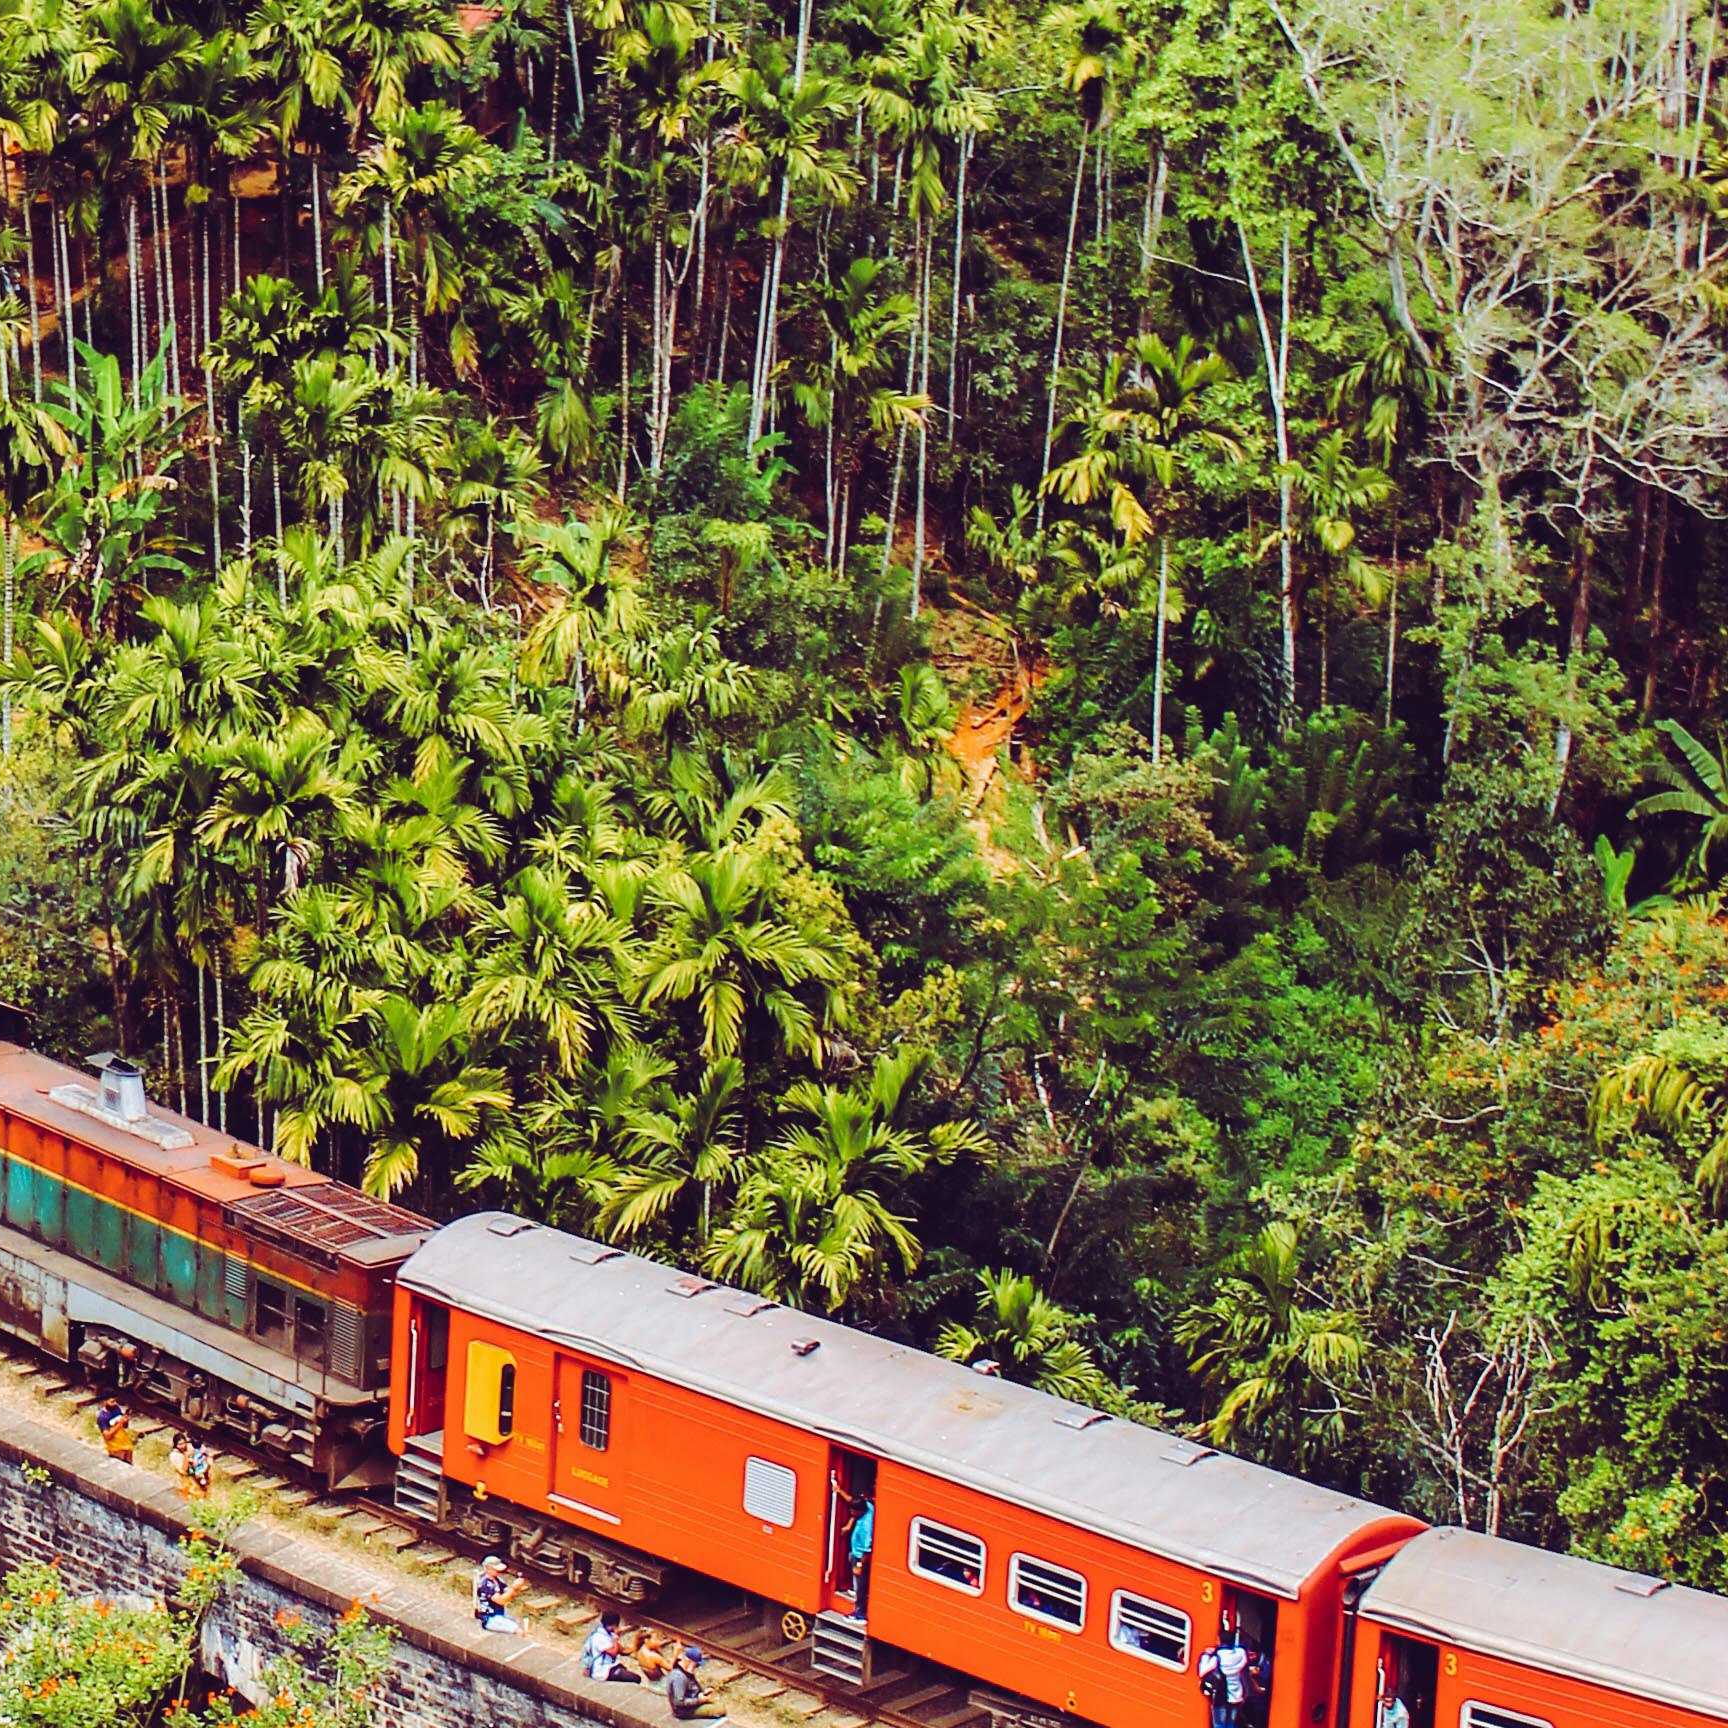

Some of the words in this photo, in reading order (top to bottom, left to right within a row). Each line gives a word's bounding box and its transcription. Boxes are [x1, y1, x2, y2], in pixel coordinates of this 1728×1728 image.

[571, 1466, 609, 1489] LUGGAGE
[1201, 1580, 1213, 1603] 3
[1444, 1652, 1457, 1676] 3
